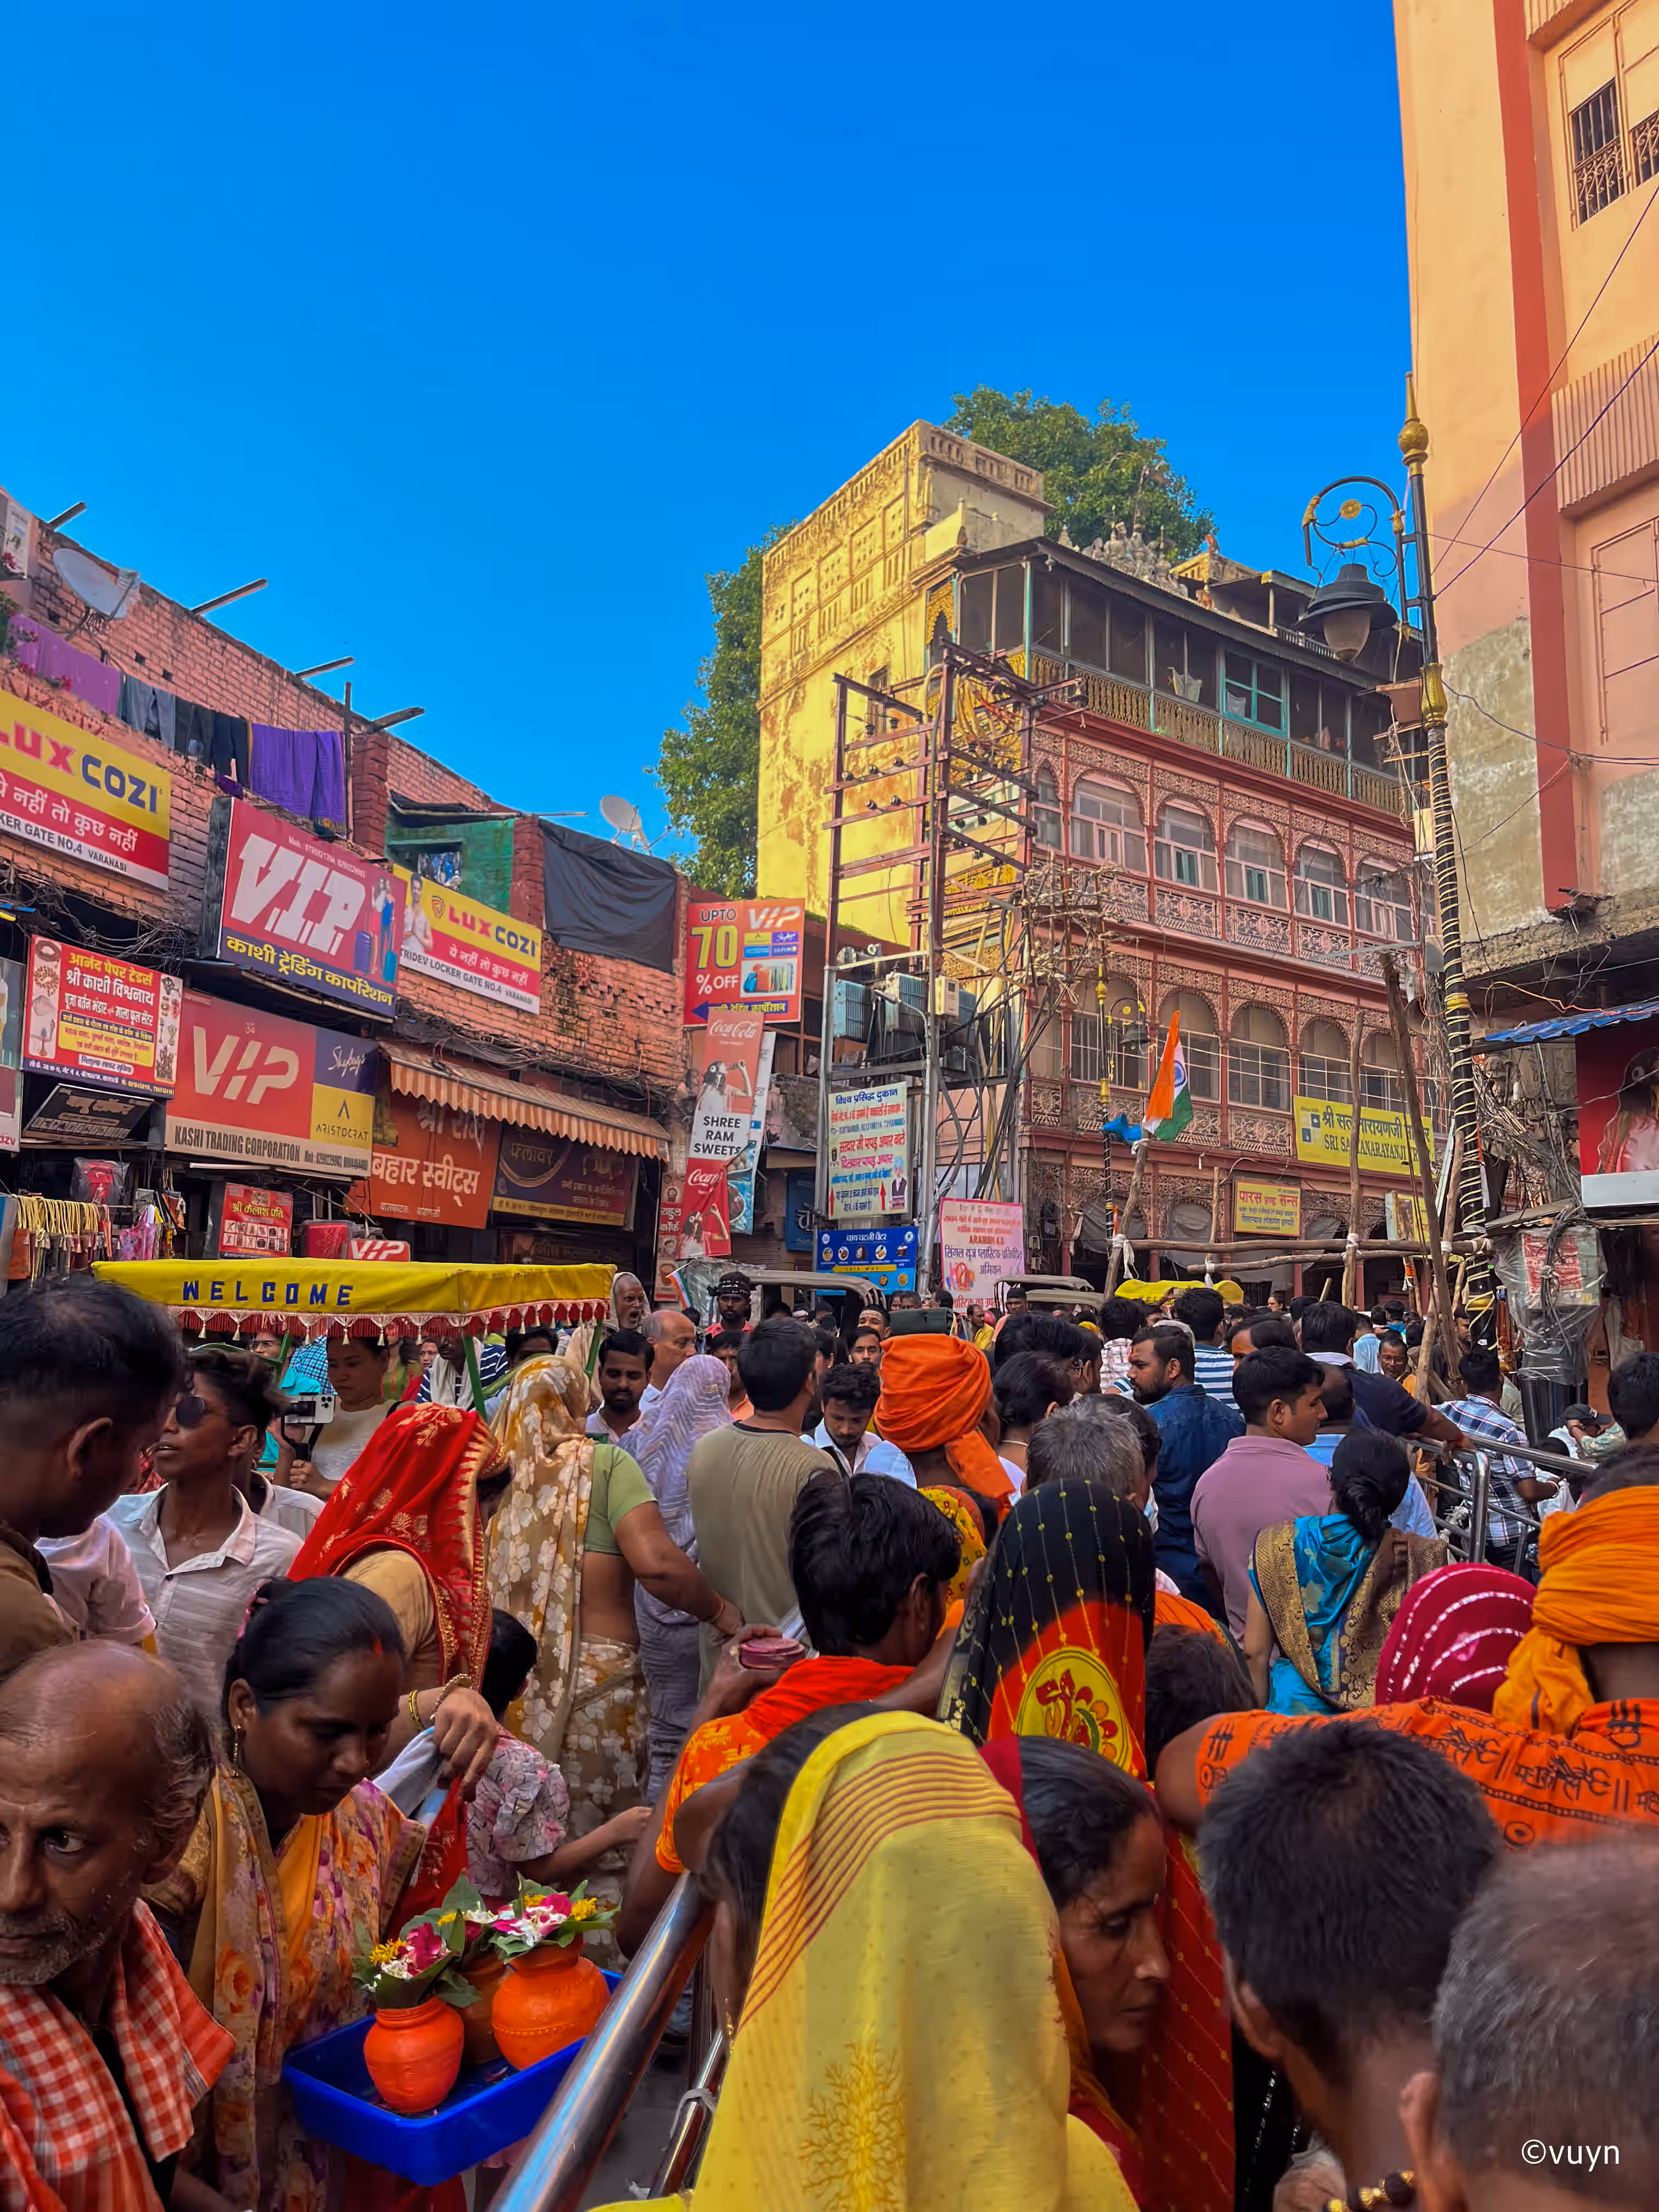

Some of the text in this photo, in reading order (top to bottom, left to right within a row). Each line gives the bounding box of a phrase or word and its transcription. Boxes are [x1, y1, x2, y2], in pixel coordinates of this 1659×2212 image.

[81, 754, 158, 815] COZI
[13, 788, 48, 814] नहीं
[51, 799, 71, 823] तो
[74, 812, 105, 837] कुछ
[109, 828, 139, 852] नहीं
[25, 821, 54, 844] GATE
[58, 835, 82, 855] NO.4
[88, 849, 127, 872] VARANASI
[230, 833, 366, 956] VIP
[701, 909, 737, 922] UPTO
[748, 906, 801, 930] VIP
[448, 905, 537, 958] LUX COZI
[226, 935, 277, 965] काशी
[278, 951, 324, 980] ट्रेडिंग
[690, 924, 739, 970] 70
[69, 952, 103, 972] आनंद
[400, 947, 429, 967] TRIDEV
[430, 959, 461, 979] LOCKER
[462, 973, 483, 988] GATE
[484, 980, 503, 994] NO.4
[449, 944, 529, 987] ये नहीं तो कुछ नहीं
[66, 967, 155, 1006] श्री काशी विश्वनाथ
[65, 992, 76, 1010] पूजा
[129, 1009, 142, 1026] फूल
[193, 1025, 300, 1105] VIP
[876, 1088, 898, 1102] दुकान
[703, 1115, 741, 1128] SHREE
[1322, 1105, 1334, 1128] श्री
[174, 1125, 203, 1148] KASHI
[206, 1131, 244, 1154] TRADING
[245, 1137, 301, 1163] CORPORATION
[315, 1123, 369, 1142] ARISTOCRAT
[706, 1129, 734, 1142] RAM
[693, 1142, 742, 1156] SWEETS
[1324, 1133, 1339, 1151] SRI
[1341, 1136, 1407, 1161] SAANARAYANJI
[372, 1152, 481, 1207] बहार स्वीट्स
[233, 1200, 242, 1212] श्री
[271, 1206, 284, 1219] पति
[1239, 1190, 1262, 1204] पारस
[1278, 1194, 1298, 1207] सन्स
[661, 1206, 681, 1220] राहुल
[350, 1239, 405, 1261] VIP
[944, 1244, 964, 1259] सिंगल
[978, 1245, 1001, 1260] प्लास्टिक
[979, 1262, 1001, 1276] अभियान
[182, 1280, 354, 1306] WELCOME
